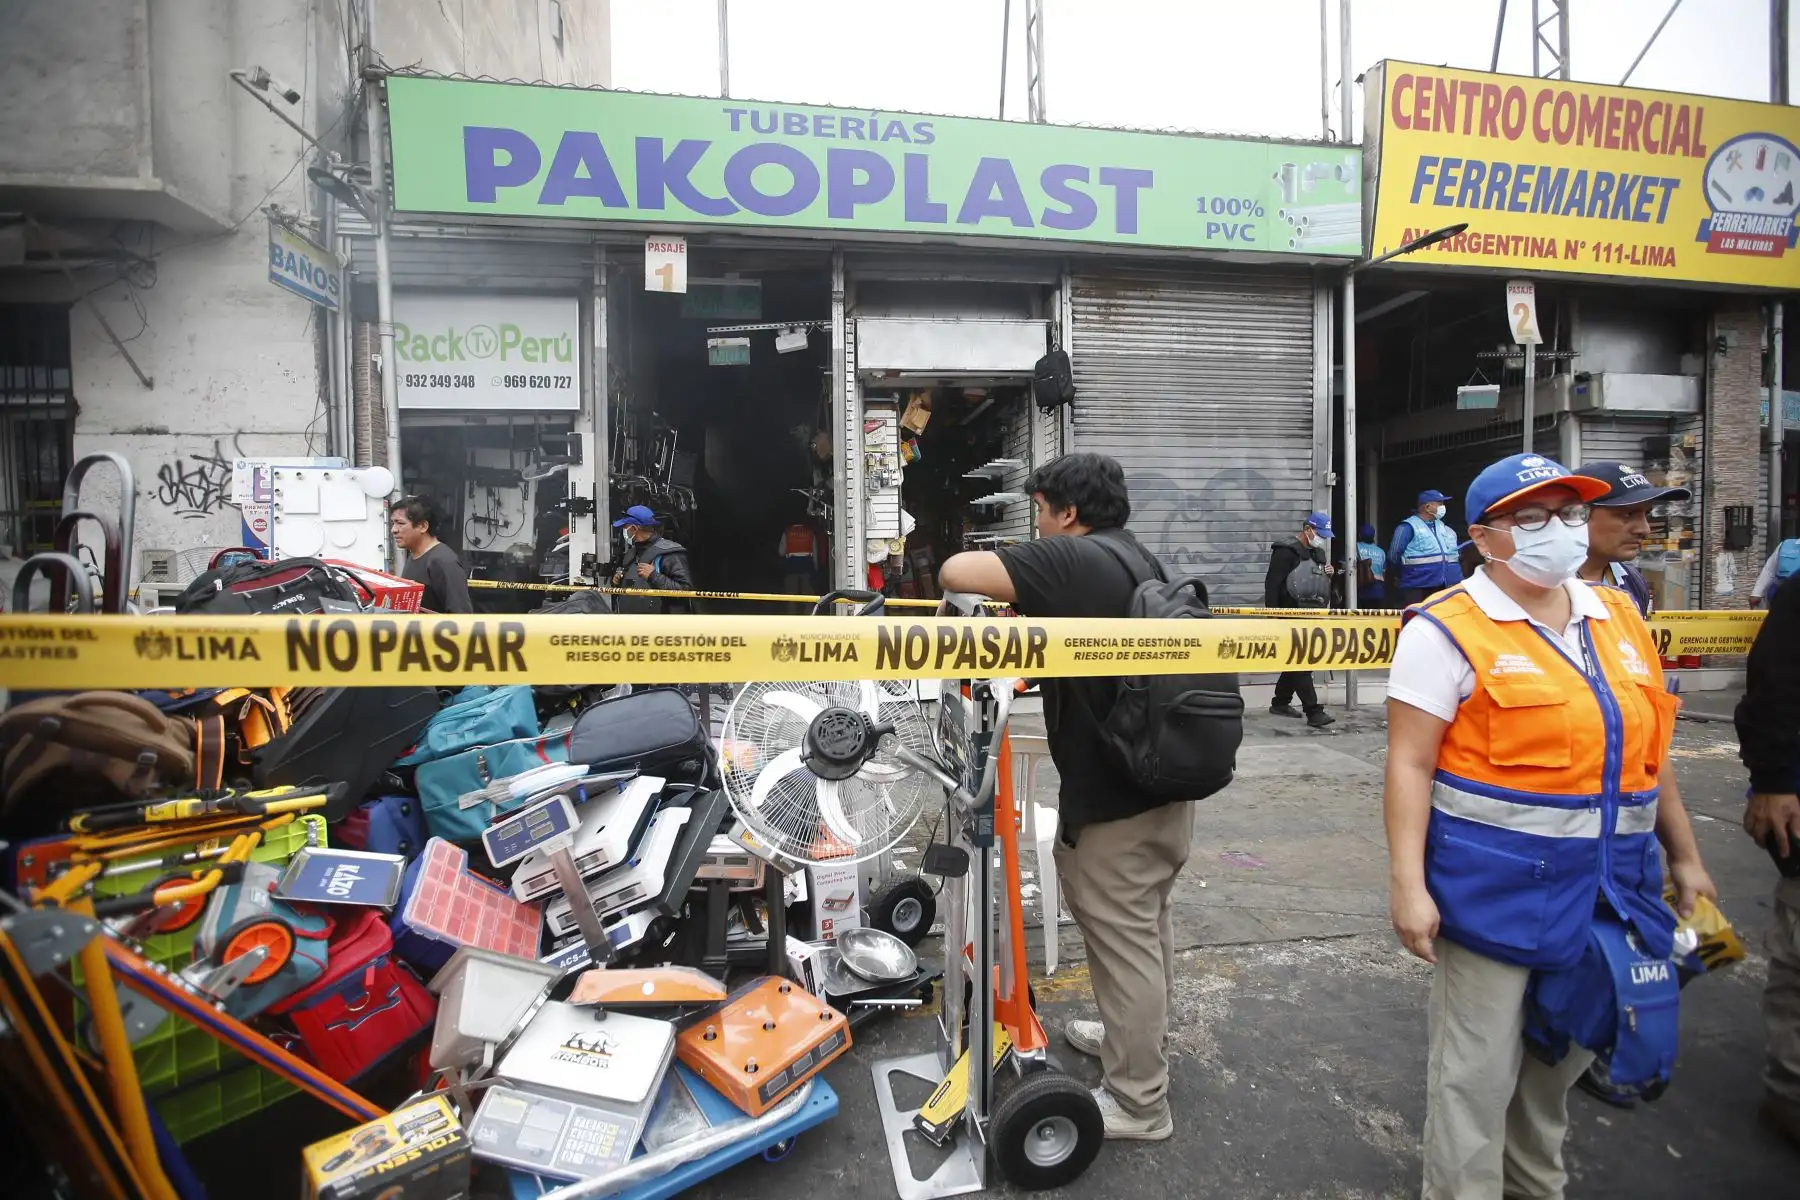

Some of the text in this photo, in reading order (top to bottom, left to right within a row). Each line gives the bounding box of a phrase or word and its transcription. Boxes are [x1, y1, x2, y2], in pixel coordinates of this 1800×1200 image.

[723, 107, 936, 145] TUBERÍAS
[1391, 73, 1706, 158] CENTRO COMERCIAL
[463, 126, 1153, 234] PAKOPLAST
[1409, 155, 1680, 224] FERREMARKET
[1196, 196, 1265, 218] 100%
[1206, 222, 1257, 242] PVC
[1709, 212, 1793, 236] FERREMARKET
[647, 242, 685, 253] PASAJE
[1437, 231, 1557, 260] ARGENTINA
[1592, 242, 1676, 267] 111-LIMA
[1721, 238, 1774, 252] LAS MALVINAS
[271, 243, 340, 296] BAÑOS
[655, 263, 673, 292] 1
[1508, 286, 1534, 294] PASAJE
[1513, 303, 1533, 336] 2
[394, 322, 573, 363] Rack Tv Perú
[405, 374, 475, 388] 932 349 348
[504, 375, 572, 389] 969 620 727
[176, 636, 261, 661] LIMA
[286, 619, 529, 672] NO PASAR
[549, 633, 746, 647] GERENCIA DE GESTIÓN DEL
[875, 624, 1048, 671] NO PASAR
[1064, 636, 1202, 647] GERENCIA DE GESTIÓN DEL
[1236, 642, 1277, 659] LIMA
[1286, 627, 1400, 665] NO PASA
[566, 651, 732, 662] RIESGO DE DESASTRES
[800, 642, 858, 662] LIMA
[1074, 651, 1191, 660] RIESGO DE DESASTRES
[560, 948, 590, 968] ACS-4
[1631, 965, 1669, 984] LIMA
[377, 1132, 461, 1174] TOLSEN
